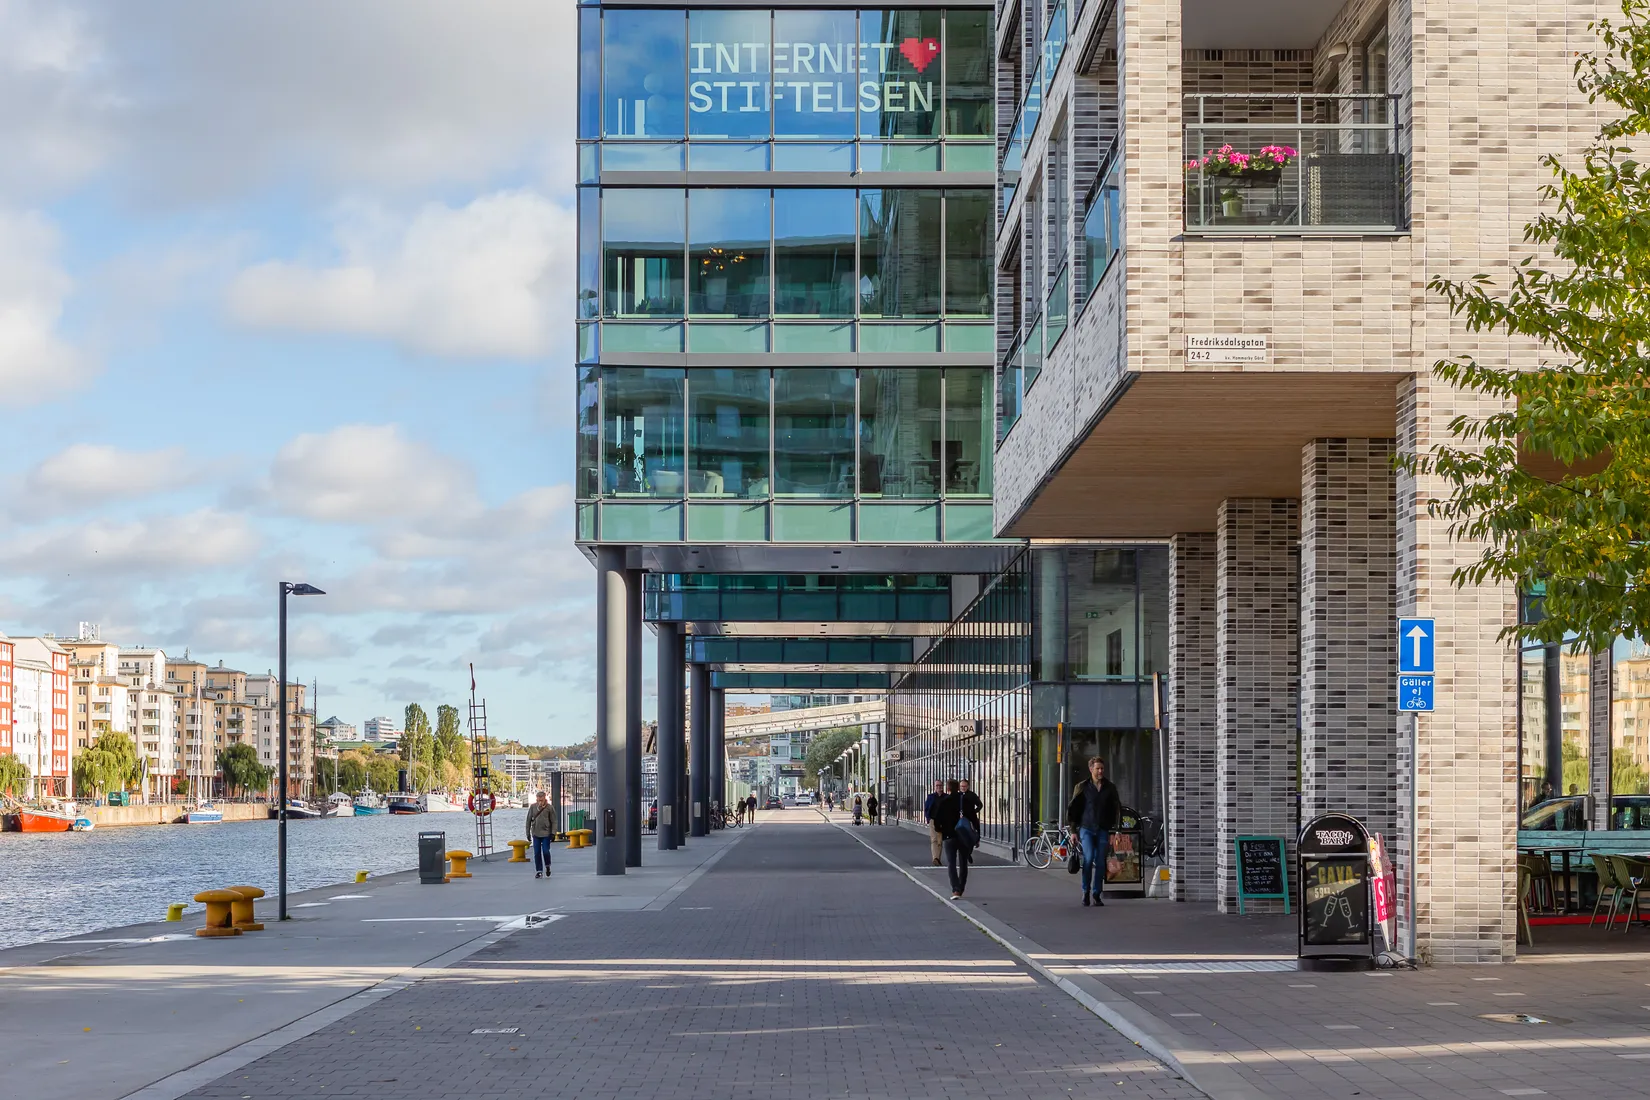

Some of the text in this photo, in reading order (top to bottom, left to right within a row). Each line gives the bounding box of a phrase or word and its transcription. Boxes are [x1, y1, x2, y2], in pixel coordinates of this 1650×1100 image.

[690, 42, 894, 73] INTERNET
[689, 81, 933, 113] STIFTELSEN
[1191, 337, 1264, 348] Fredriksdalsgatan
[1191, 351, 1211, 360] 24-2
[1402, 678, 1431, 686] Gäller
[1412, 686, 1421, 696] ej
[960, 725, 974, 733] 10A
[1316, 830, 1344, 838] TACO
[1321, 837, 1343, 845] BAR
